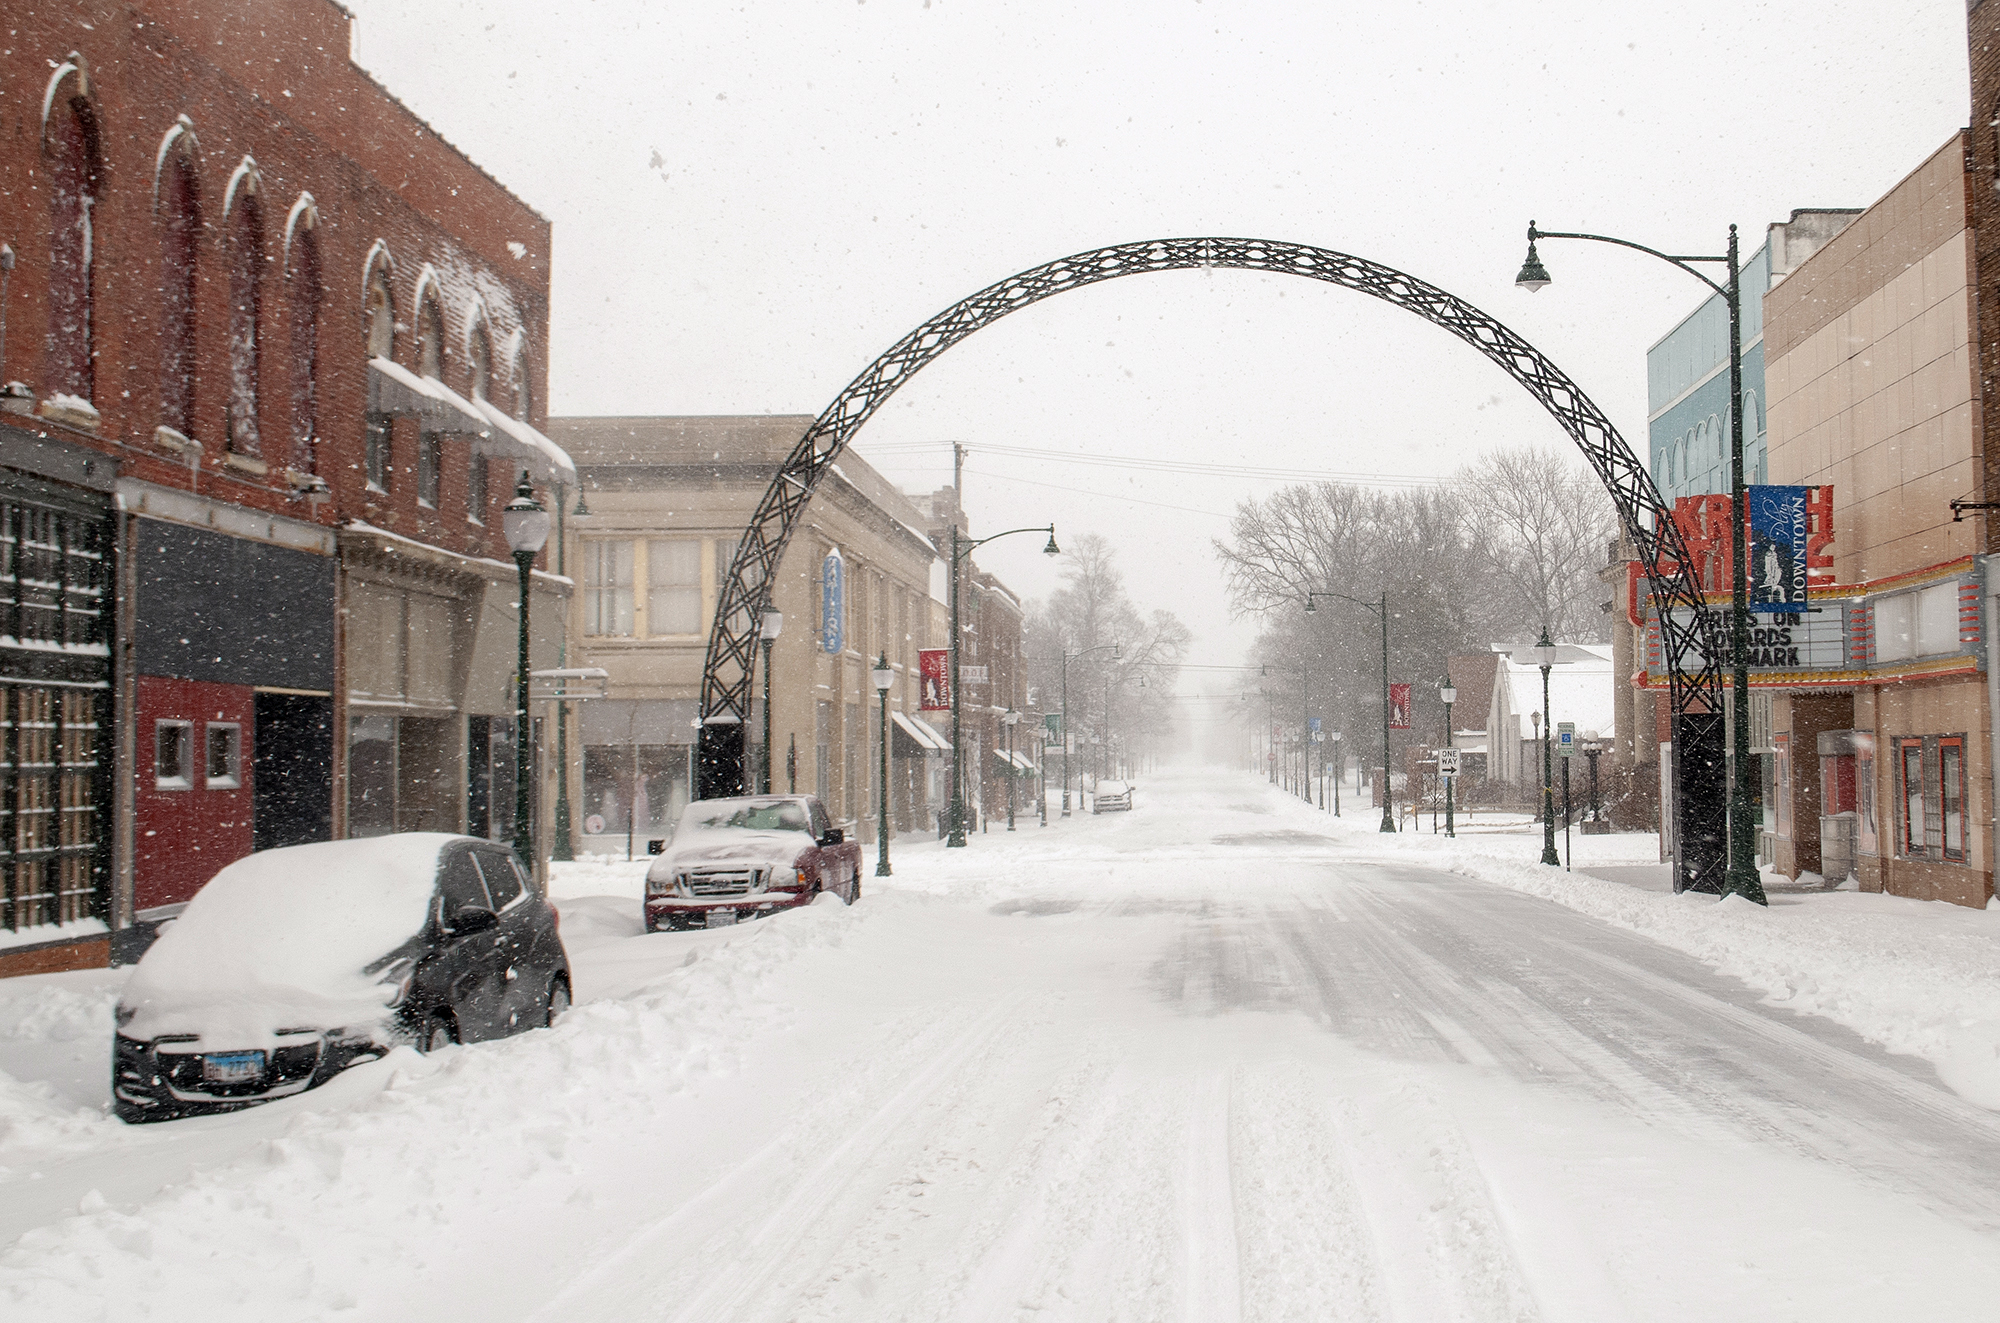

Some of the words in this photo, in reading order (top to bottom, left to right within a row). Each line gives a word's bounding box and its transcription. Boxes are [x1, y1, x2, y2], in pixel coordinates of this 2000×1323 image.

[1792, 496, 1806, 602] DOWNTOWN
[1701, 610, 1758, 628] PRES
[1773, 611, 1801, 627] ON
[1703, 627, 1792, 648] OWARDS
[1709, 649, 1734, 667] HE
[1746, 647, 1800, 666] MARK
[940, 655, 948, 706] DOWNTOWN
